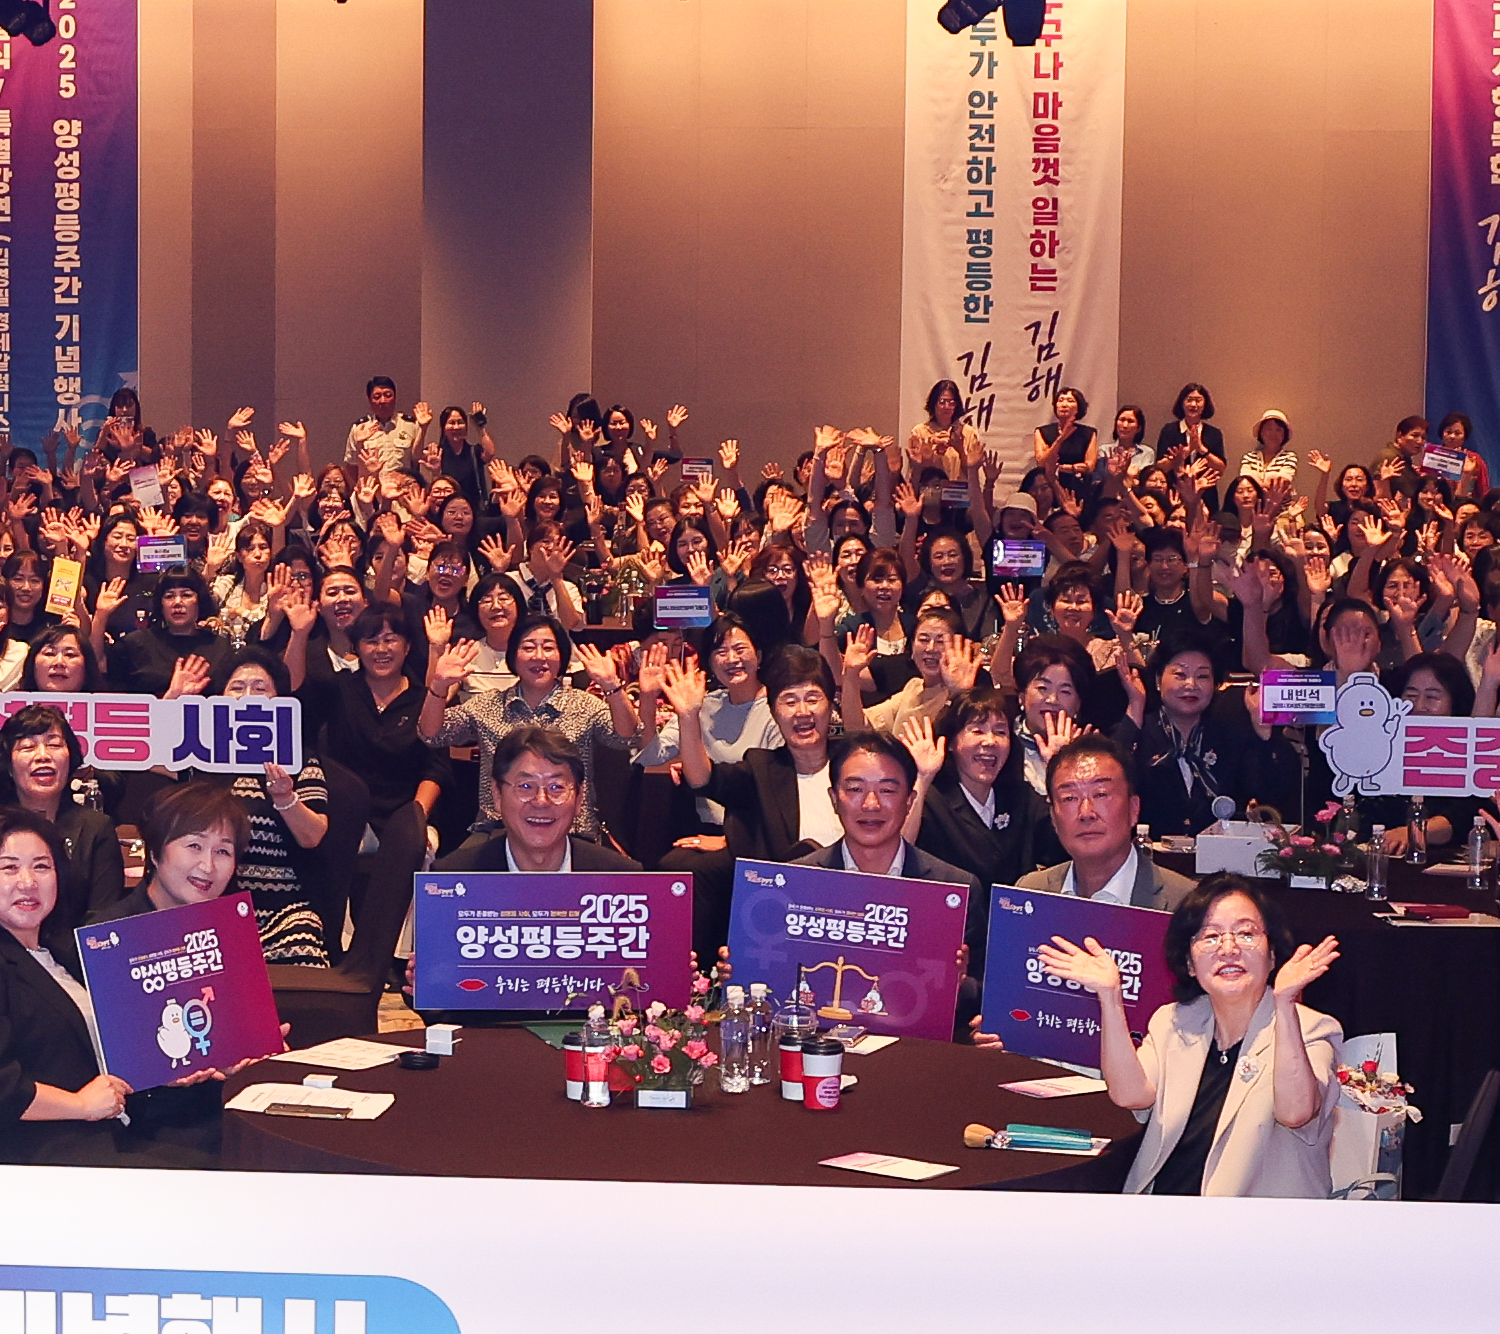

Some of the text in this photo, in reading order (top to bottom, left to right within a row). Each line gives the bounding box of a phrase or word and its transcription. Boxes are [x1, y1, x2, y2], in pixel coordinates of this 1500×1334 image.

[966, 91, 998, 219] 안전하고
[1031, 92, 1064, 187] 마음껏
[53, 119, 83, 304] 양성평등주간
[963, 228, 994, 324] 평등한
[1029, 197, 1061, 292] 일하는
[53, 315, 83, 435] 기념행사
[957, 341, 995, 432] 김해
[1023, 311, 1063, 406] 김해
[1281, 689, 1320, 701] 내빈석
[172, 703, 294, 766] 사회
[580, 894, 649, 924] 2025
[785, 913, 907, 948] 양성평등주간
[864, 903, 908, 926] 2025
[183, 928, 219, 954] 2025
[456, 925, 650, 959] 양성평등주간
[495, 974, 605, 995] 우리는 평등합니다
[1036, 1010, 1062, 1028] 우리는
